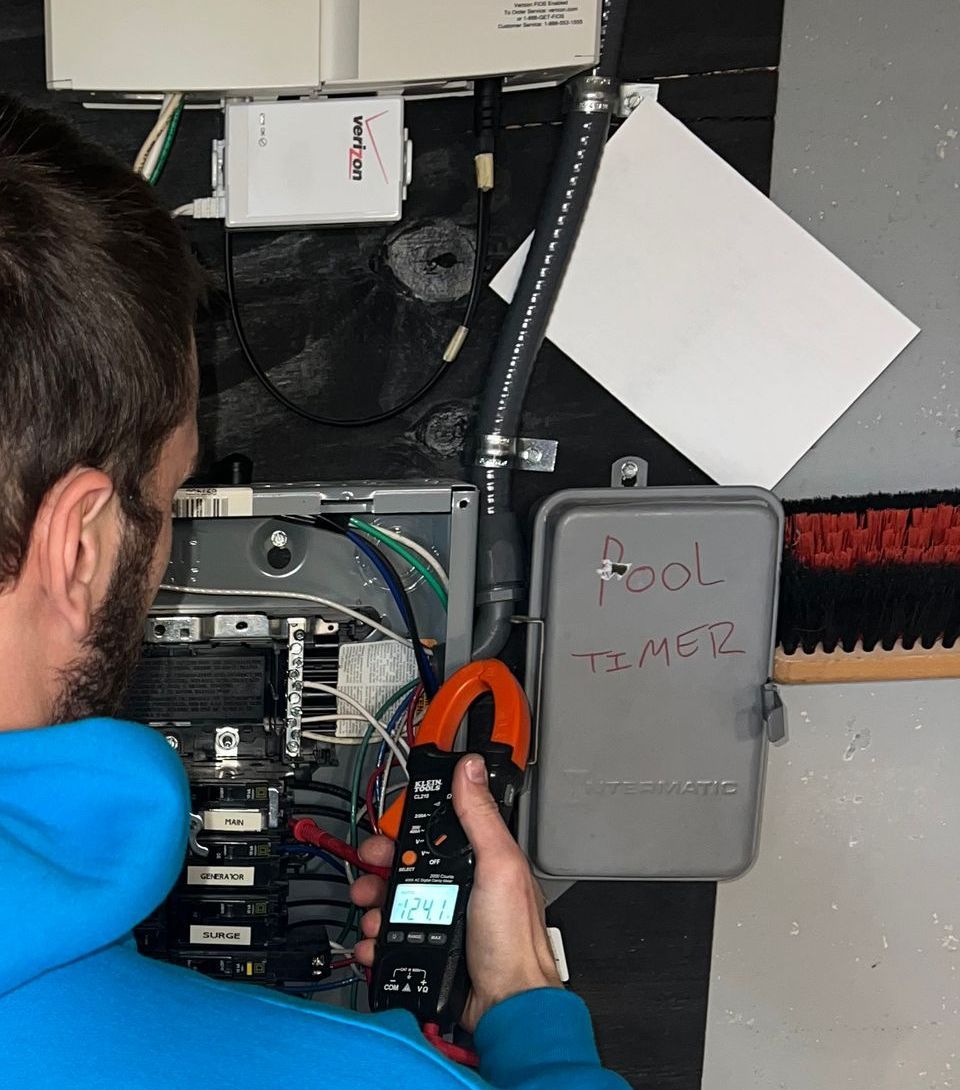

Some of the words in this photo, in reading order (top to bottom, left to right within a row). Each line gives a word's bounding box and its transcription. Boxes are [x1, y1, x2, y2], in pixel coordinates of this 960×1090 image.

[349, 116, 366, 180] verizon
[597, 535, 725, 606] POOL
[571, 621, 746, 674] TIMER
[224, 818, 245, 826] MAIN
[200, 872, 244, 881] GENERATOR
[202, 931, 241, 940] SURGE
